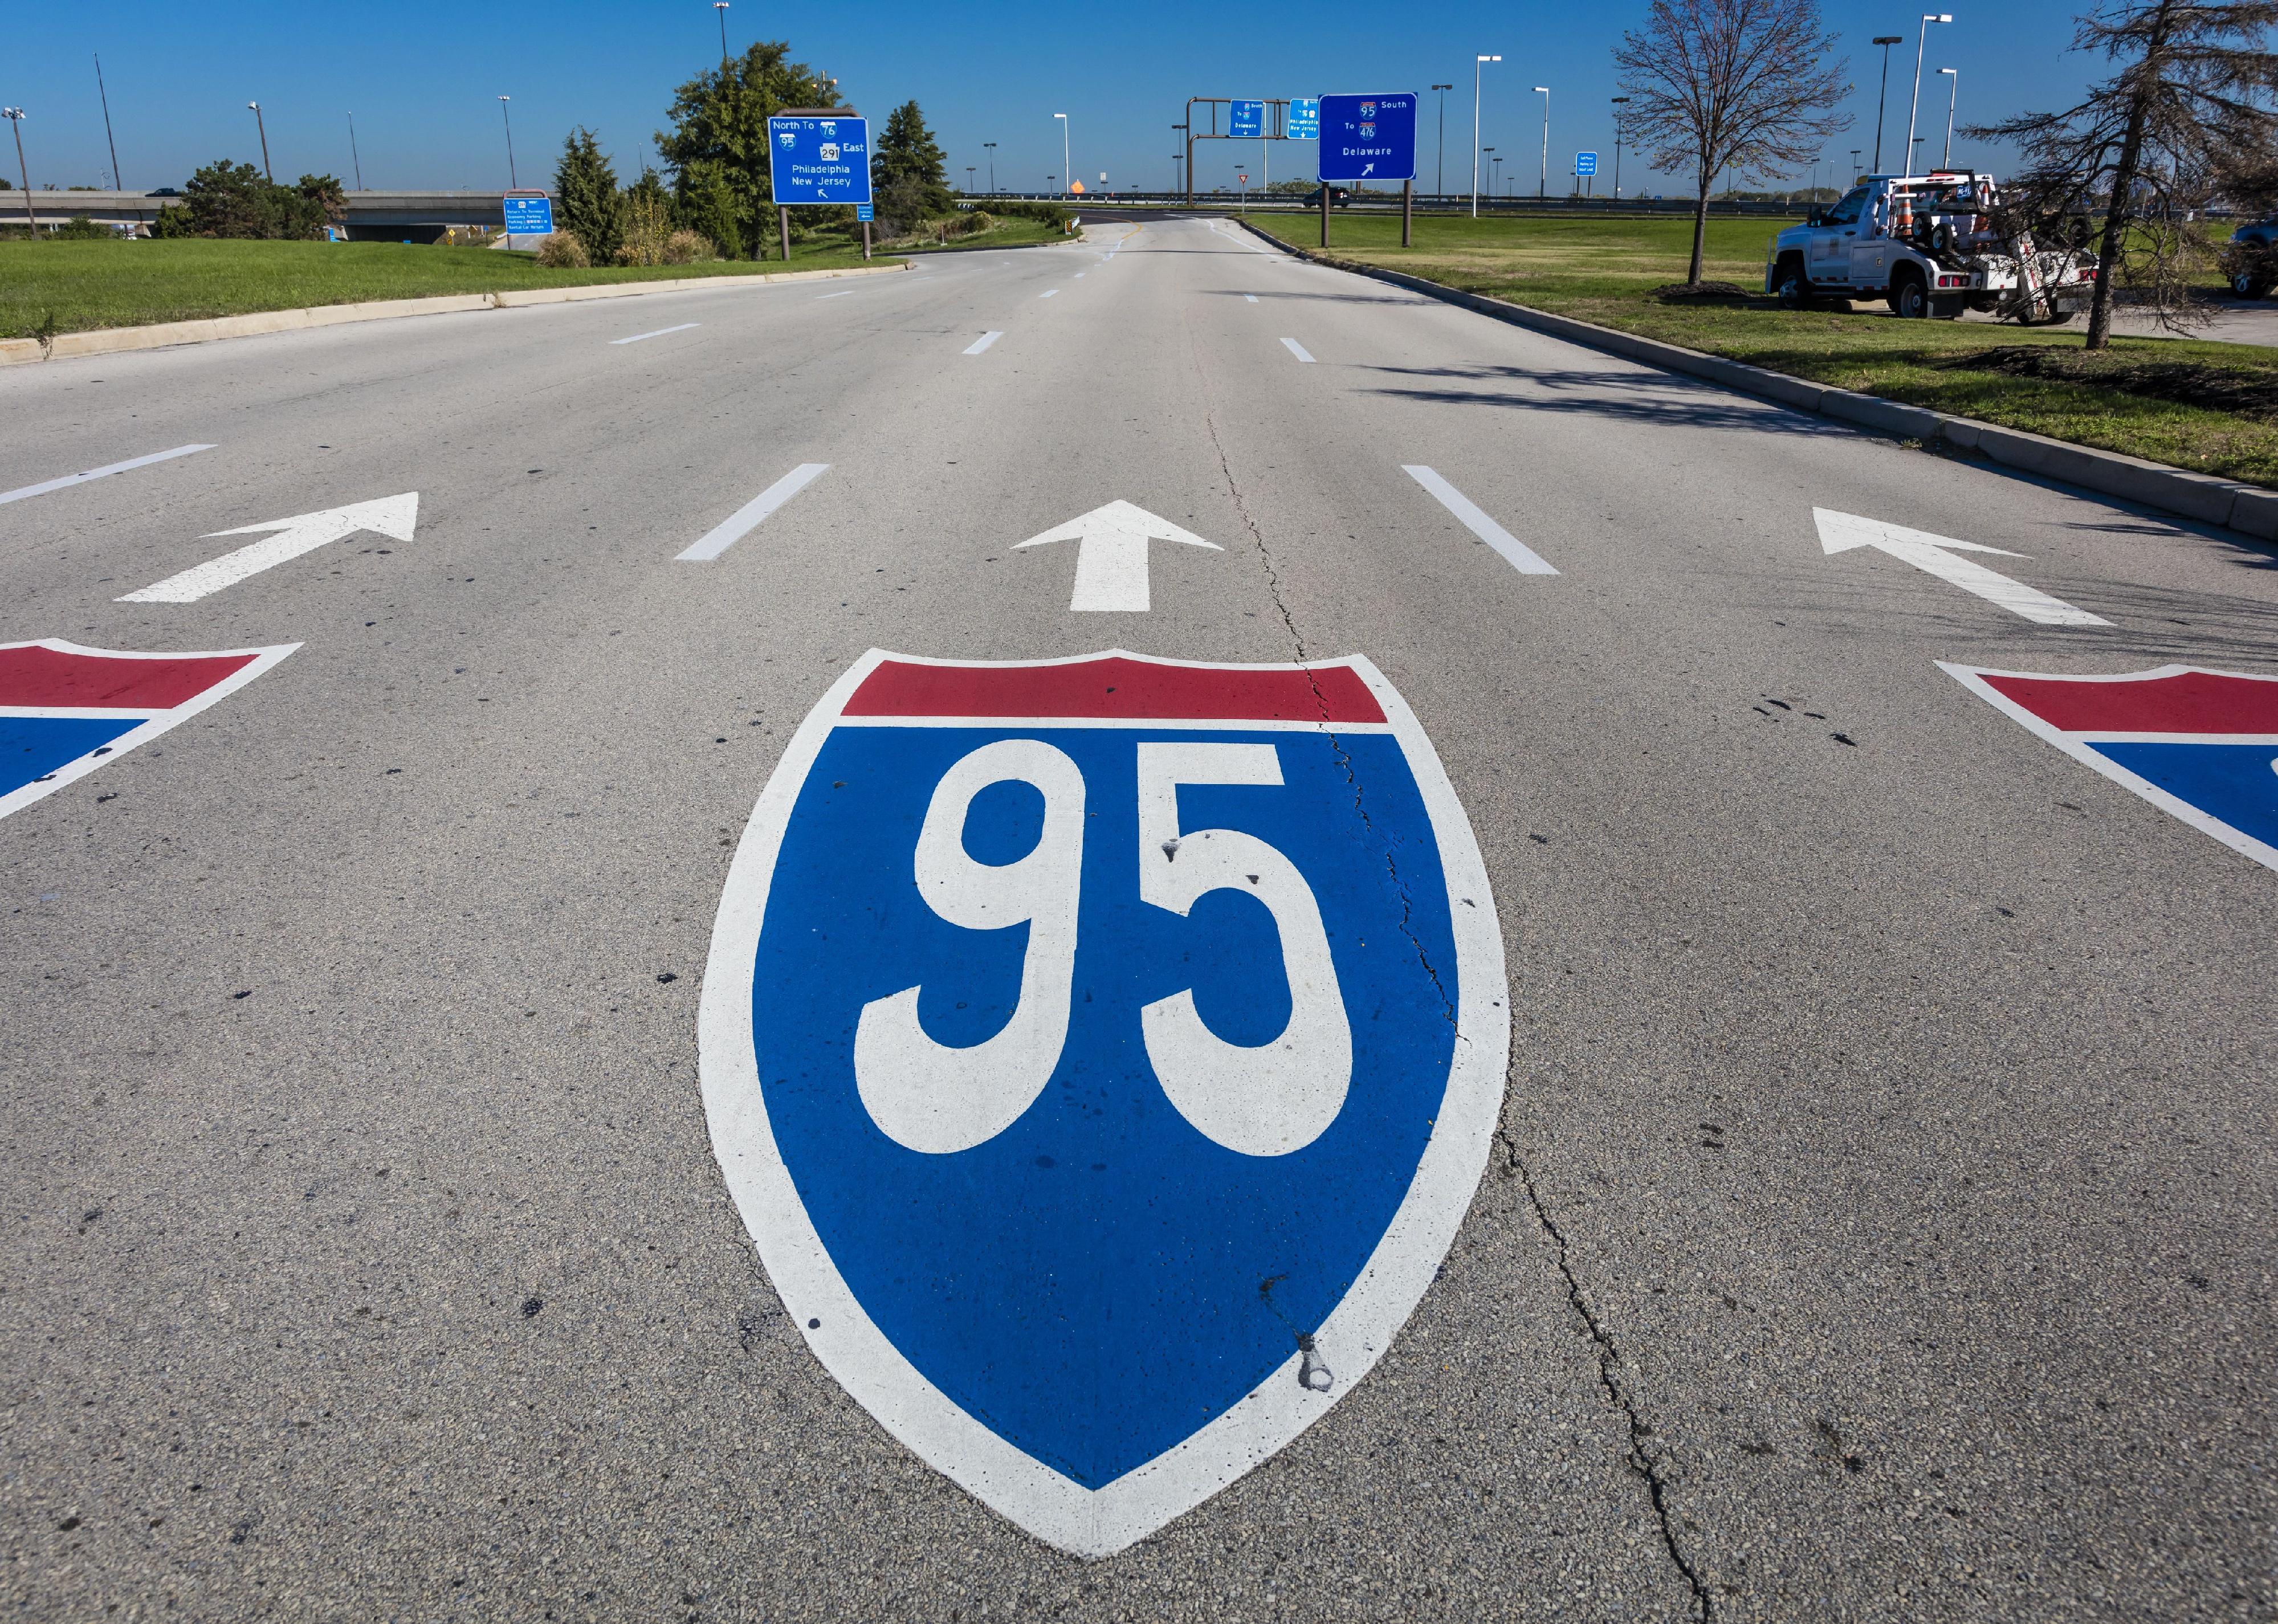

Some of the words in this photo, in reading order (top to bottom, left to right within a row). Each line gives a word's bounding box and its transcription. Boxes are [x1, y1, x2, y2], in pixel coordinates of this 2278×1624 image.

[1361, 107, 1375, 117] 95
[773, 121, 800, 130] North
[802, 121, 814, 130] To
[822, 126, 835, 135] 76
[1360, 128, 1374, 137] 476
[781, 138, 794, 147] 95
[822, 149, 838, 158] 291
[843, 143, 865, 152] East
[792, 165, 850, 175] Philadelphia
[792, 177, 812, 185] New
[818, 177, 851, 187] Jersey
[854, 739, 1352, 1157] 95
